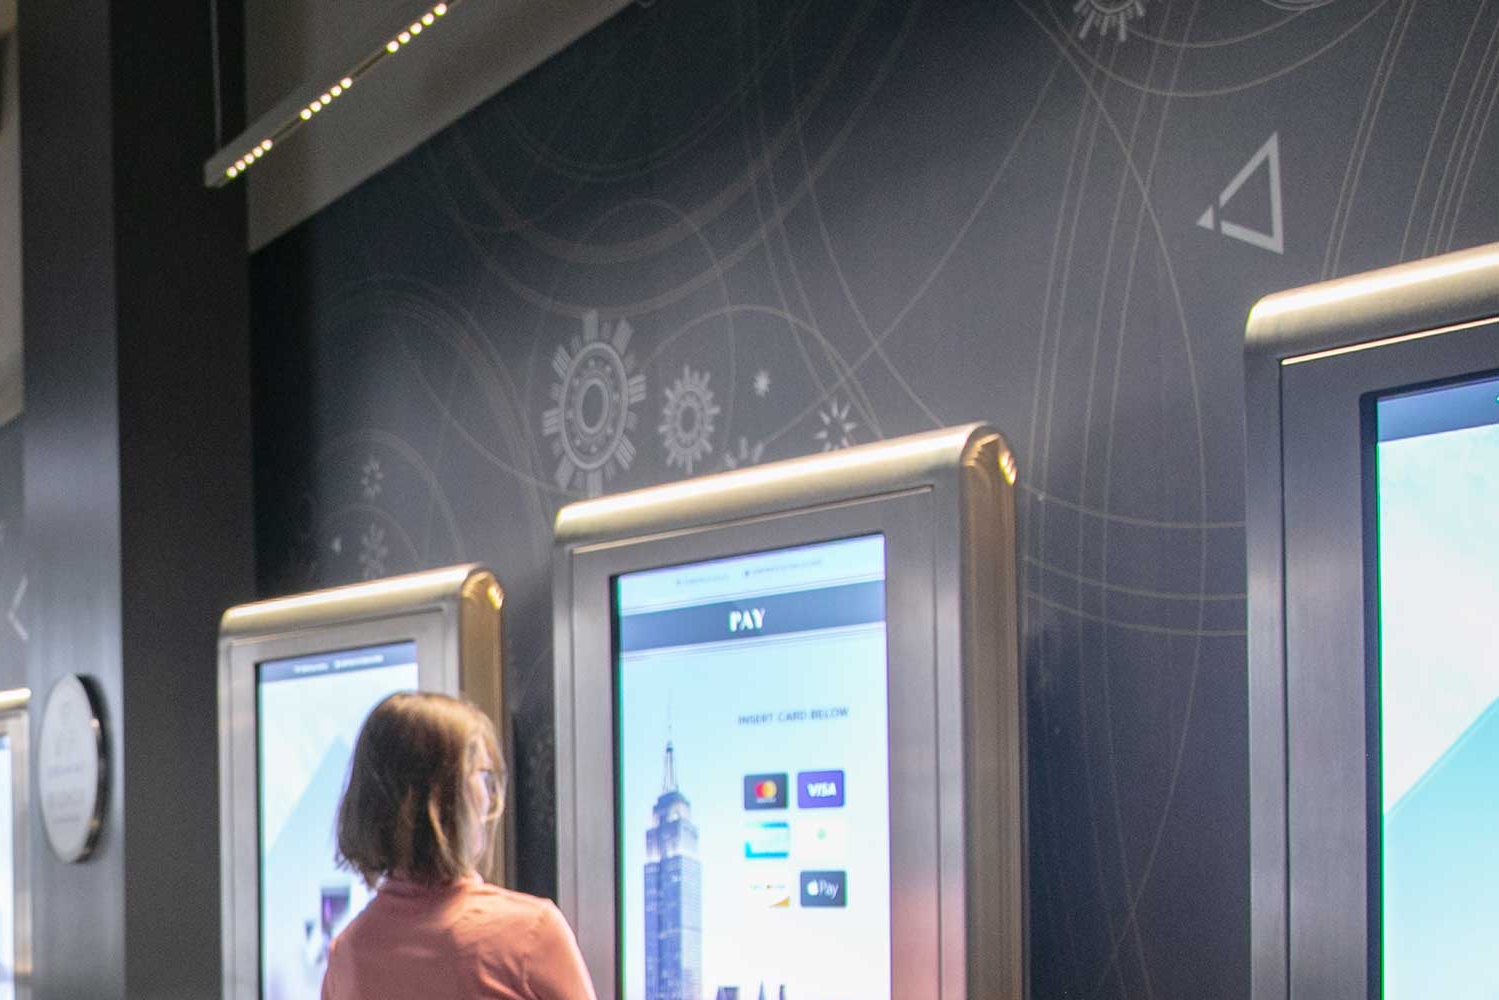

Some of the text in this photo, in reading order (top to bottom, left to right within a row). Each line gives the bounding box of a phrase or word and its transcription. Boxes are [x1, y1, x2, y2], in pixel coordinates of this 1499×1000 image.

[729, 607, 766, 632] PAY
[738, 706, 849, 725] INSERT CARD BELOW
[807, 782, 837, 797] VISA
[819, 880, 839, 899] Pay
